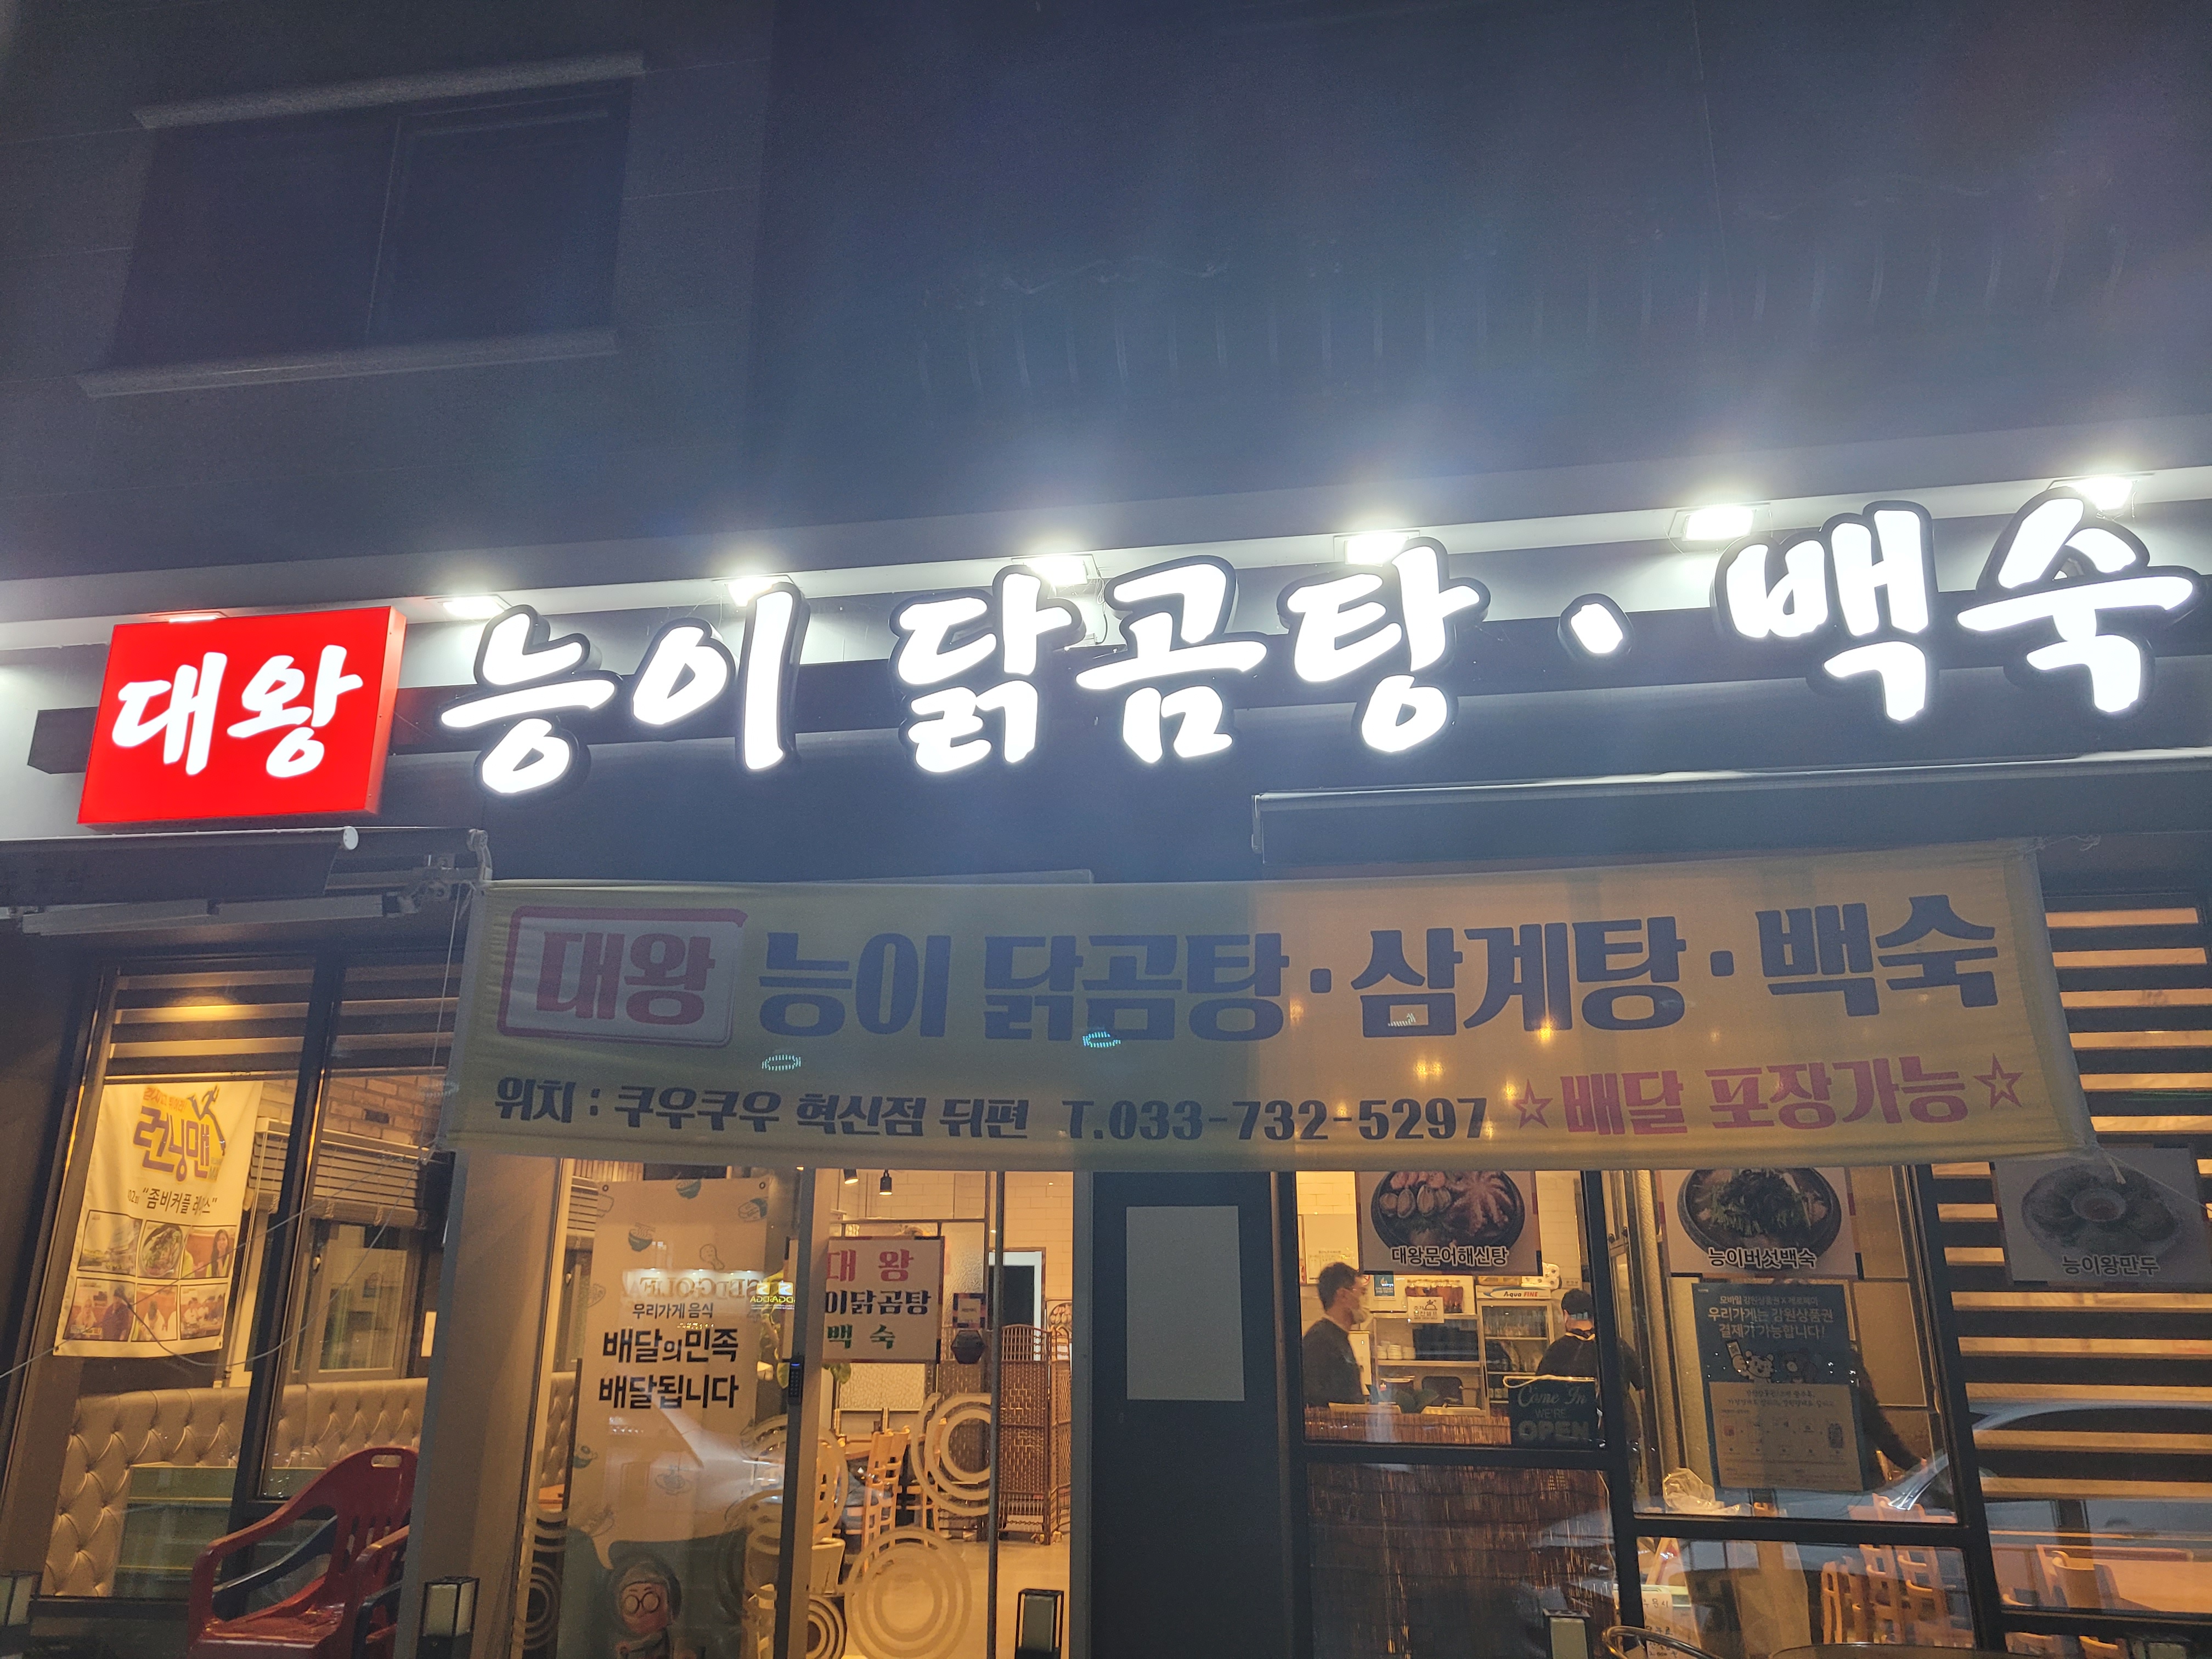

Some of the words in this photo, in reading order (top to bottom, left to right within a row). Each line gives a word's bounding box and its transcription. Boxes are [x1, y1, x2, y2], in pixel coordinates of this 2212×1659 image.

[442, 588, 792, 793] 능이
[899, 540, 1479, 772] 닭곰탕
[1727, 499, 2192, 721] 백숙
[112, 645, 363, 778] 대왕
[536, 932, 715, 1025] 대왕
[758, 932, 951, 1037] 능이
[615, 1085, 782, 1132] 쿠우쿠우
[797, 1093, 926, 1137] 혁신점
[939, 1098, 1029, 1139] 뒤편
[1561, 1070, 1688, 1135] 배달
[1705, 1056, 1969, 1130] 포장가능
[133, 1105, 210, 1182] 런닝맨
[1391, 1245, 1509, 1266] 대왕문어해신탕
[1708, 1247, 1817, 1268] 능이버섯백숙
[2061, 1255, 2160, 1276] 능이왕만두
[633, 1302, 685, 1319] 우리가게
[688, 1302, 714, 1319] 음식
[1708, 1307, 1769, 1322] 우리가게는
[602, 1328, 738, 1363] 배달의민족
[599, 1375, 739, 1409] 배달됩니다
[1517, 1385, 1560, 1408] Come
[1517, 1420, 1589, 1442] OPEN
